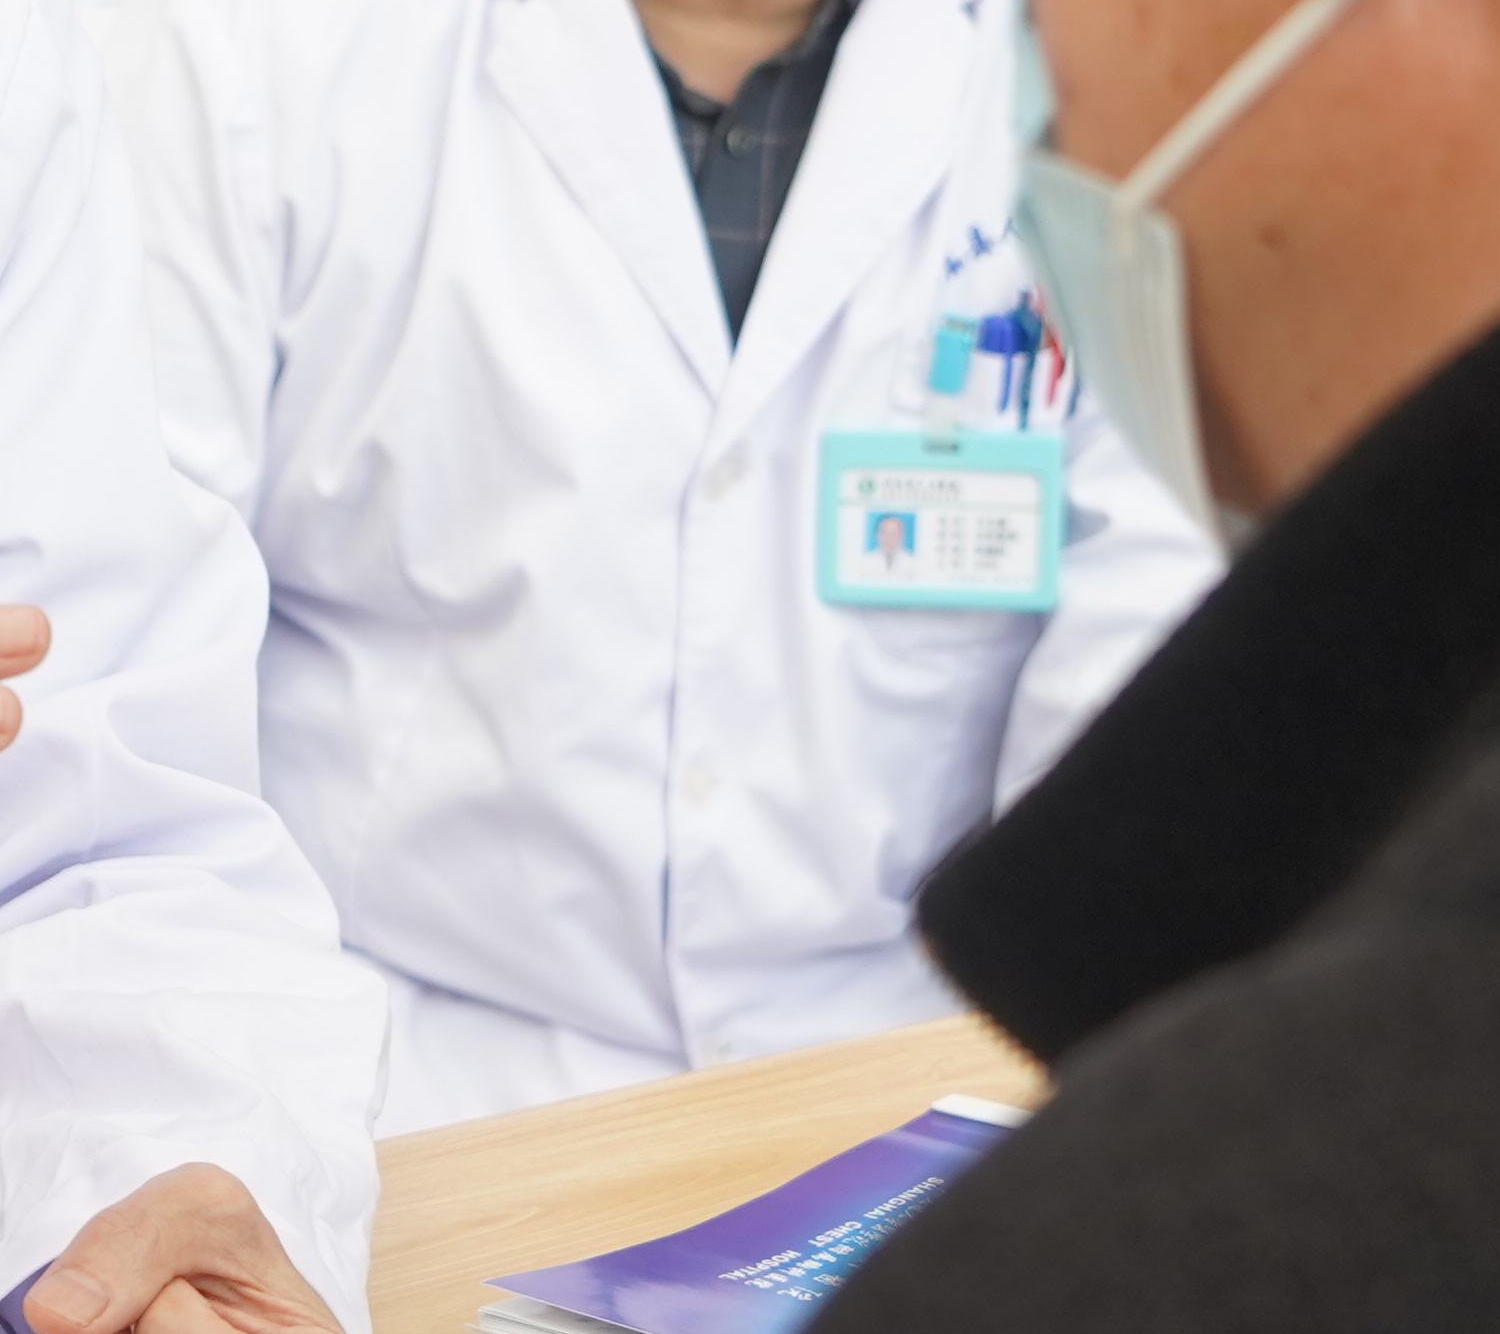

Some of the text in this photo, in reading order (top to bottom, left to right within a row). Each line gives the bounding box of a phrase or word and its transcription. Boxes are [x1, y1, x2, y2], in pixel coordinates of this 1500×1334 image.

[718, 1176, 945, 1281] SHANGHAI CHEST HOSPITAL
